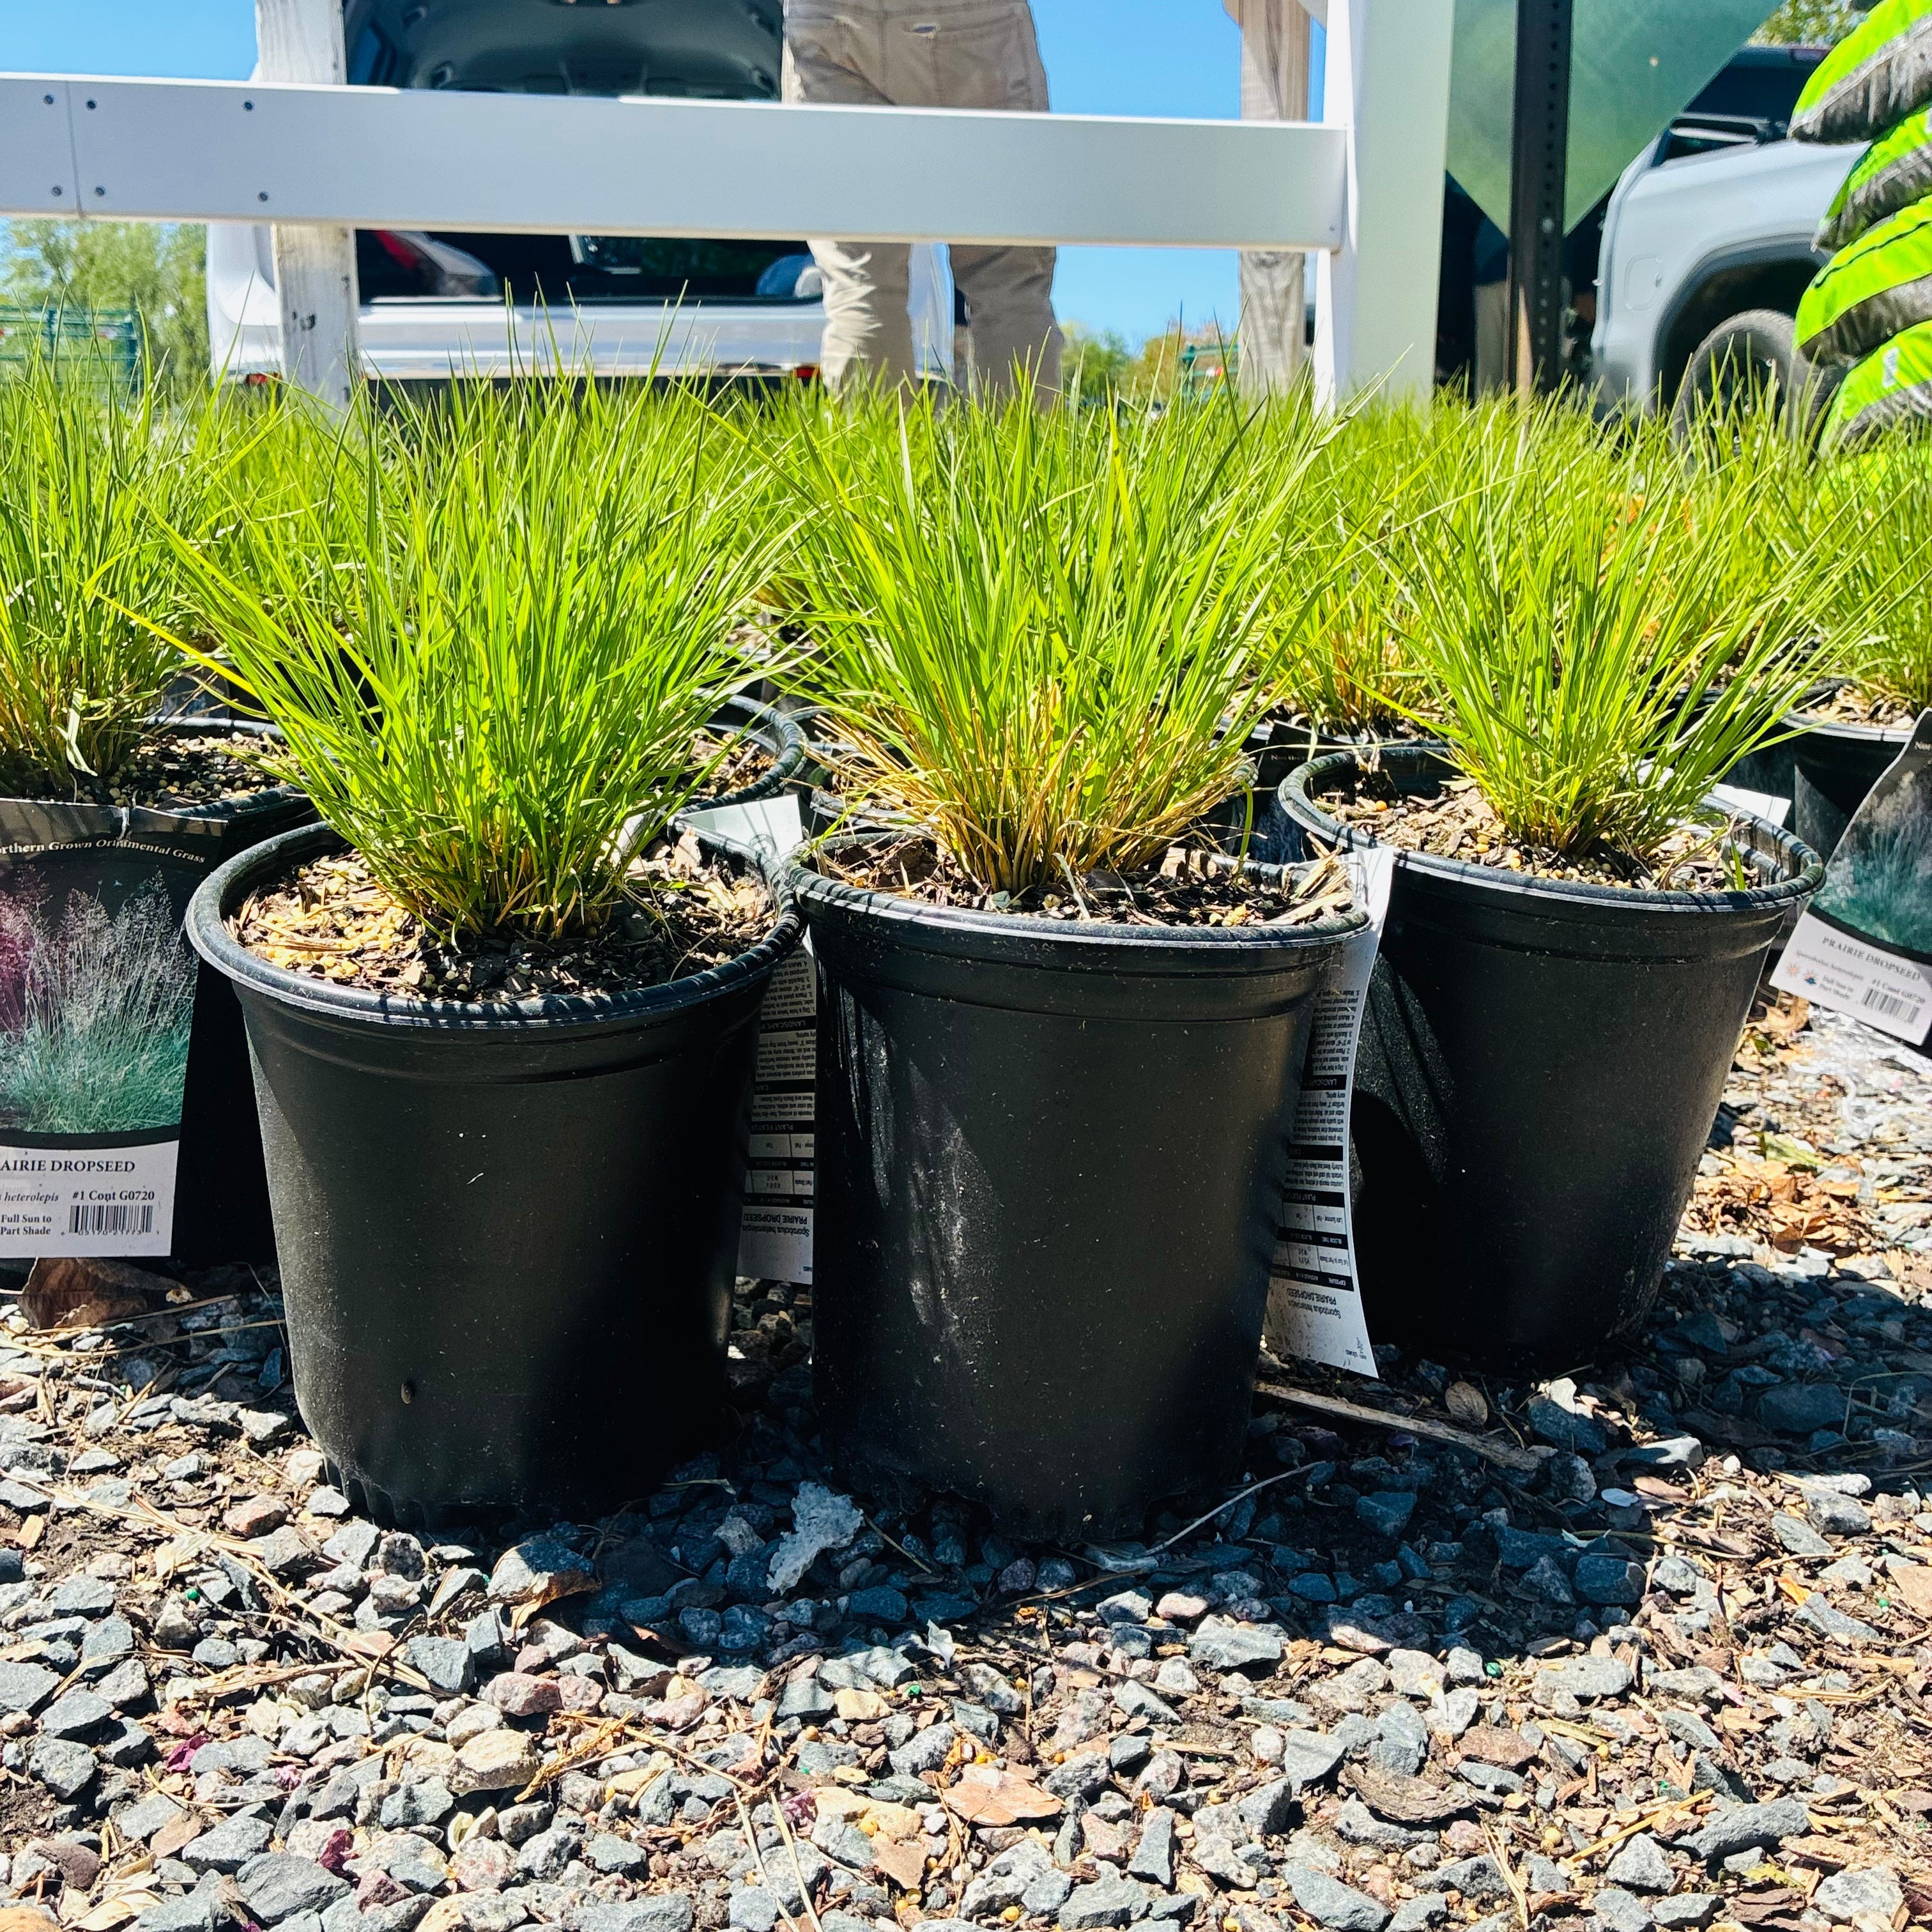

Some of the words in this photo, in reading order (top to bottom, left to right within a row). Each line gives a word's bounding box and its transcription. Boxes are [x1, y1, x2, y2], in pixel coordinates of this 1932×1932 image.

[0, 843, 45, 854] rthern
[49, 841, 92, 850] Grown
[172, 849, 206, 863] Grass
[1822, 936, 1864, 959] PRAIRIE
[1865, 953, 1920, 981] DROPSEED
[767, 1020, 805, 1029] LANDSCAPE
[0, 1160, 47, 1172] AIRIE
[50, 1160, 135, 1172] DROPSEED
[4, 1192, 59, 1204] heterolepis
[72, 1192, 84, 1200] #1
[89, 1190, 116, 1200] Cont
[119, 1191, 155, 1200] G0720
[1, 1215, 20, 1223] Full
[22, 1215, 40, 1223] Sun
[744, 1213, 781, 1223] DROPSEED
[781, 1215, 807, 1224] PRAIRIE
[1, 1227, 20, 1235] Part
[23, 1227, 51, 1235] Shade
